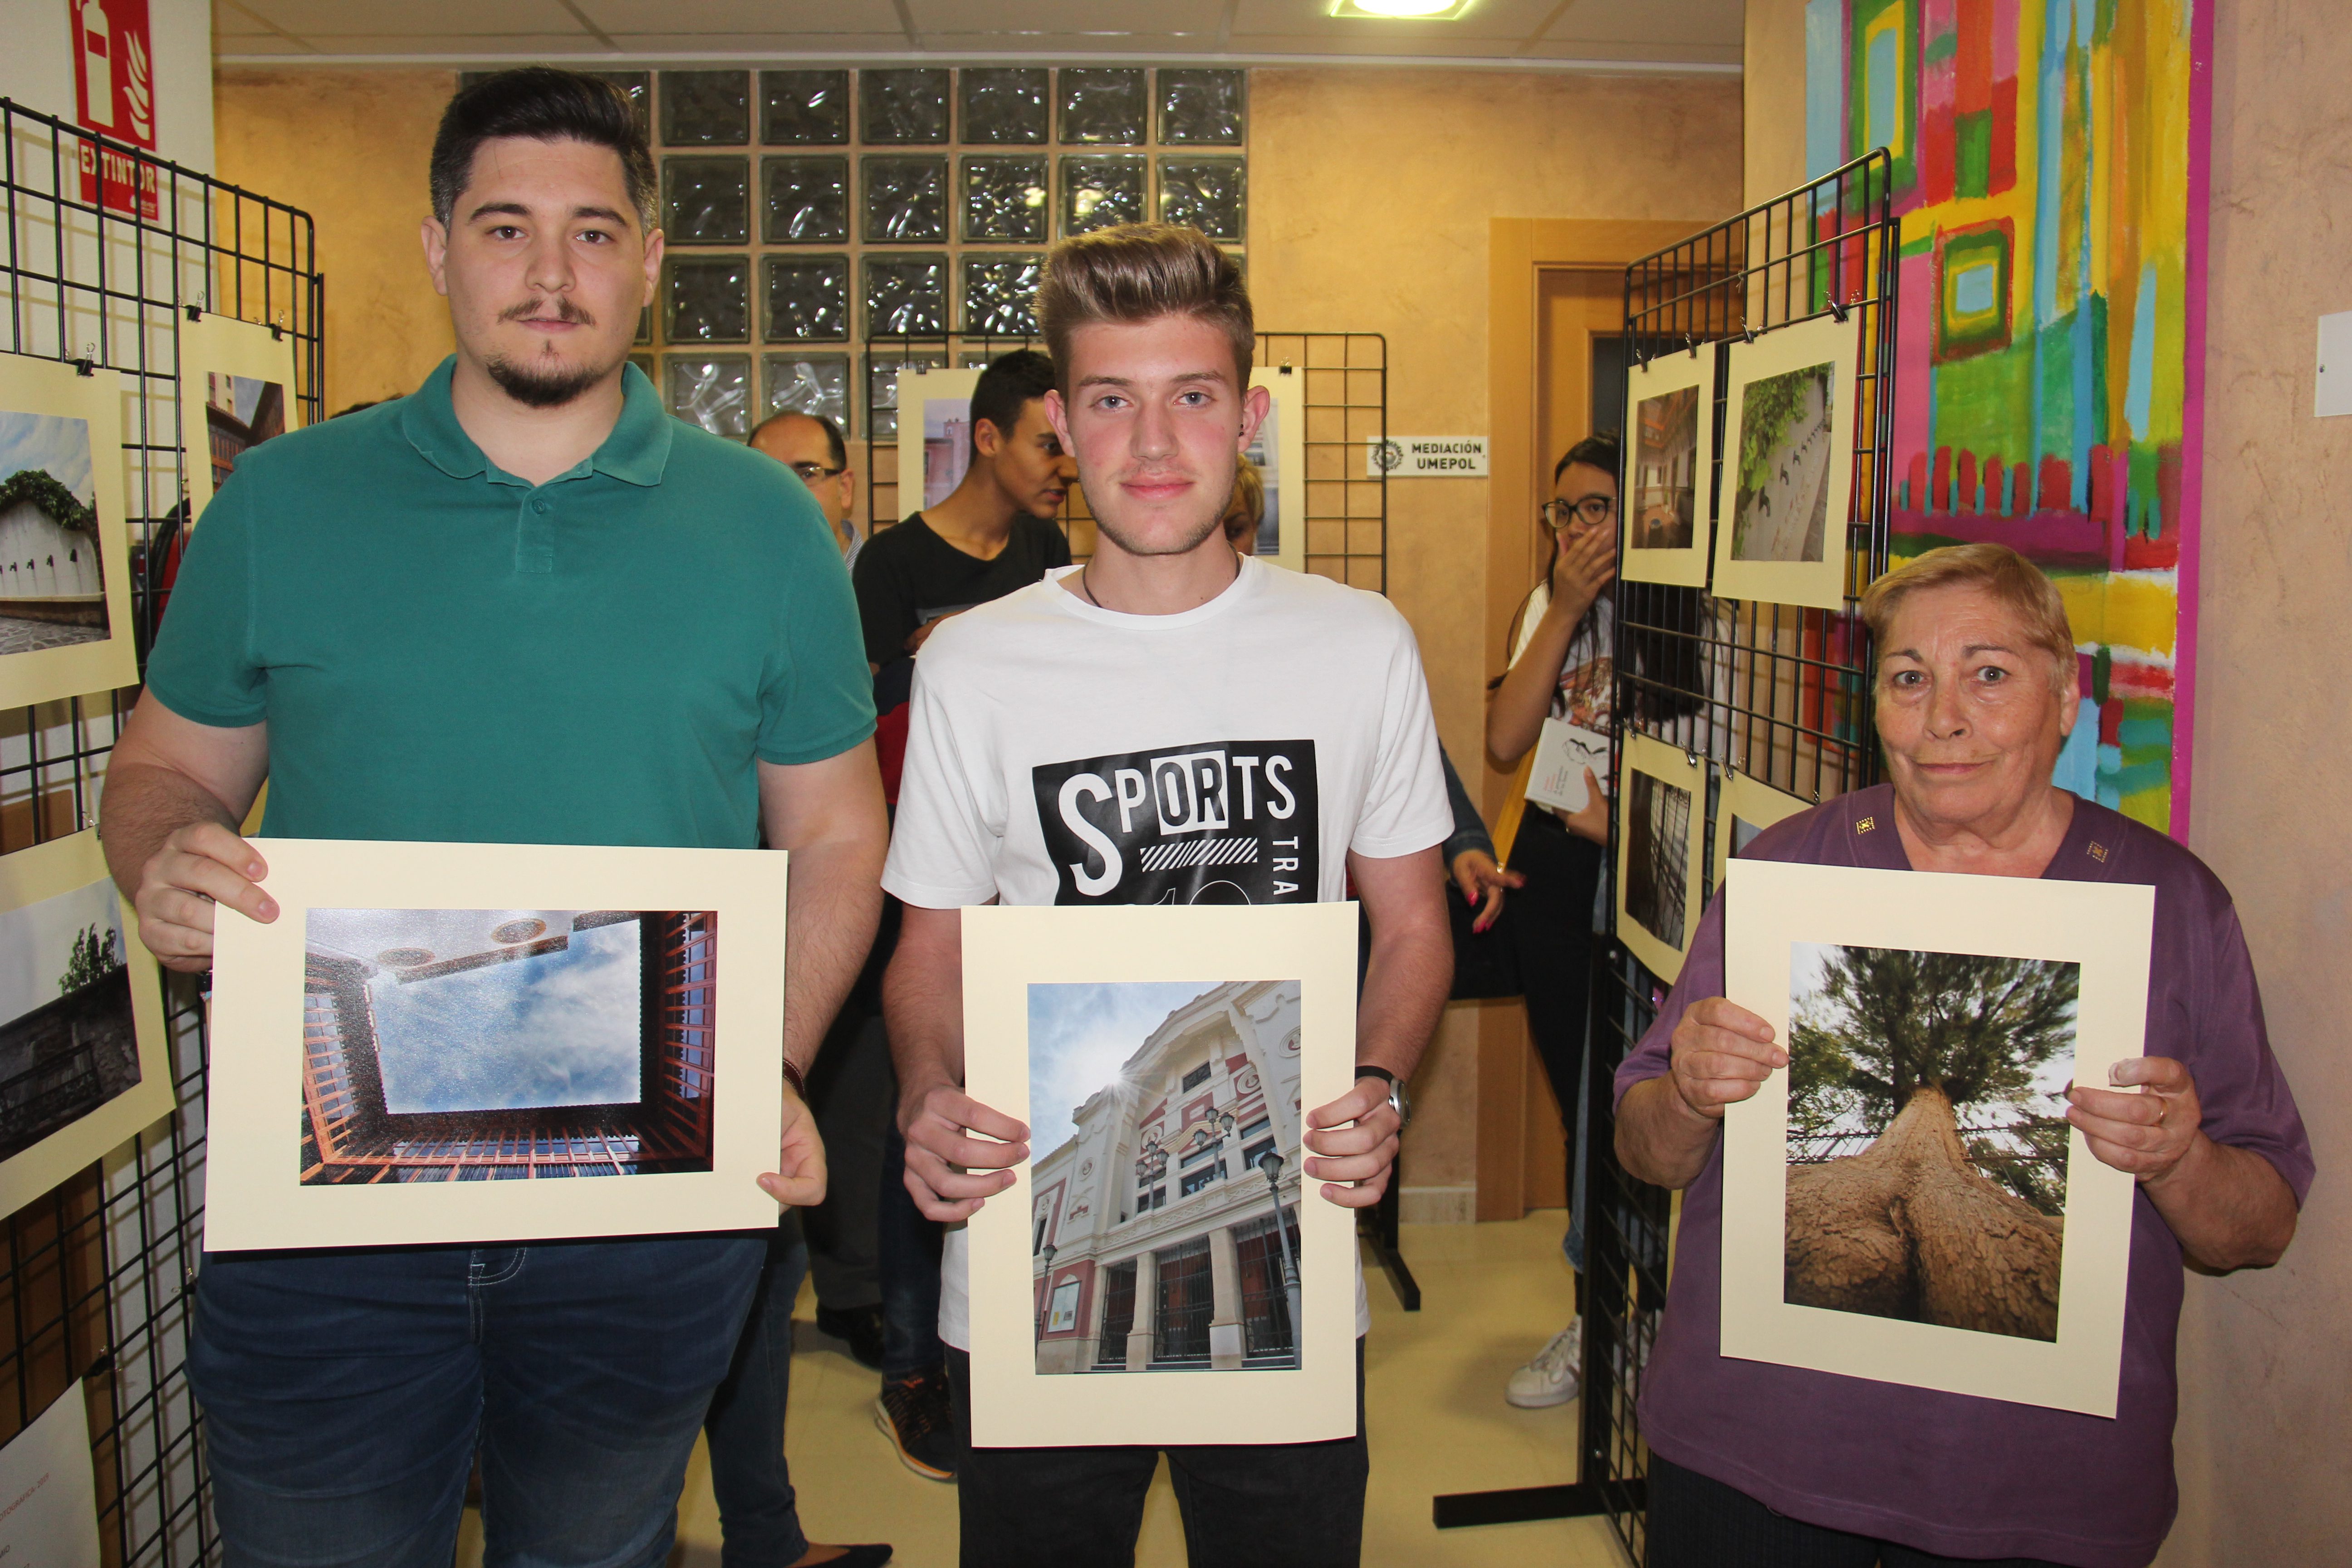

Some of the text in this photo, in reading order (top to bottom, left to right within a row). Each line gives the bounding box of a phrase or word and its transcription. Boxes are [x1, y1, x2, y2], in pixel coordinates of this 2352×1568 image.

[1411, 440, 1481, 453] MEDIACIÓN
[1417, 458, 1475, 469] UMEPOL
[1058, 755, 1296, 897] SPORTS
[1272, 836, 1298, 895] TRA
